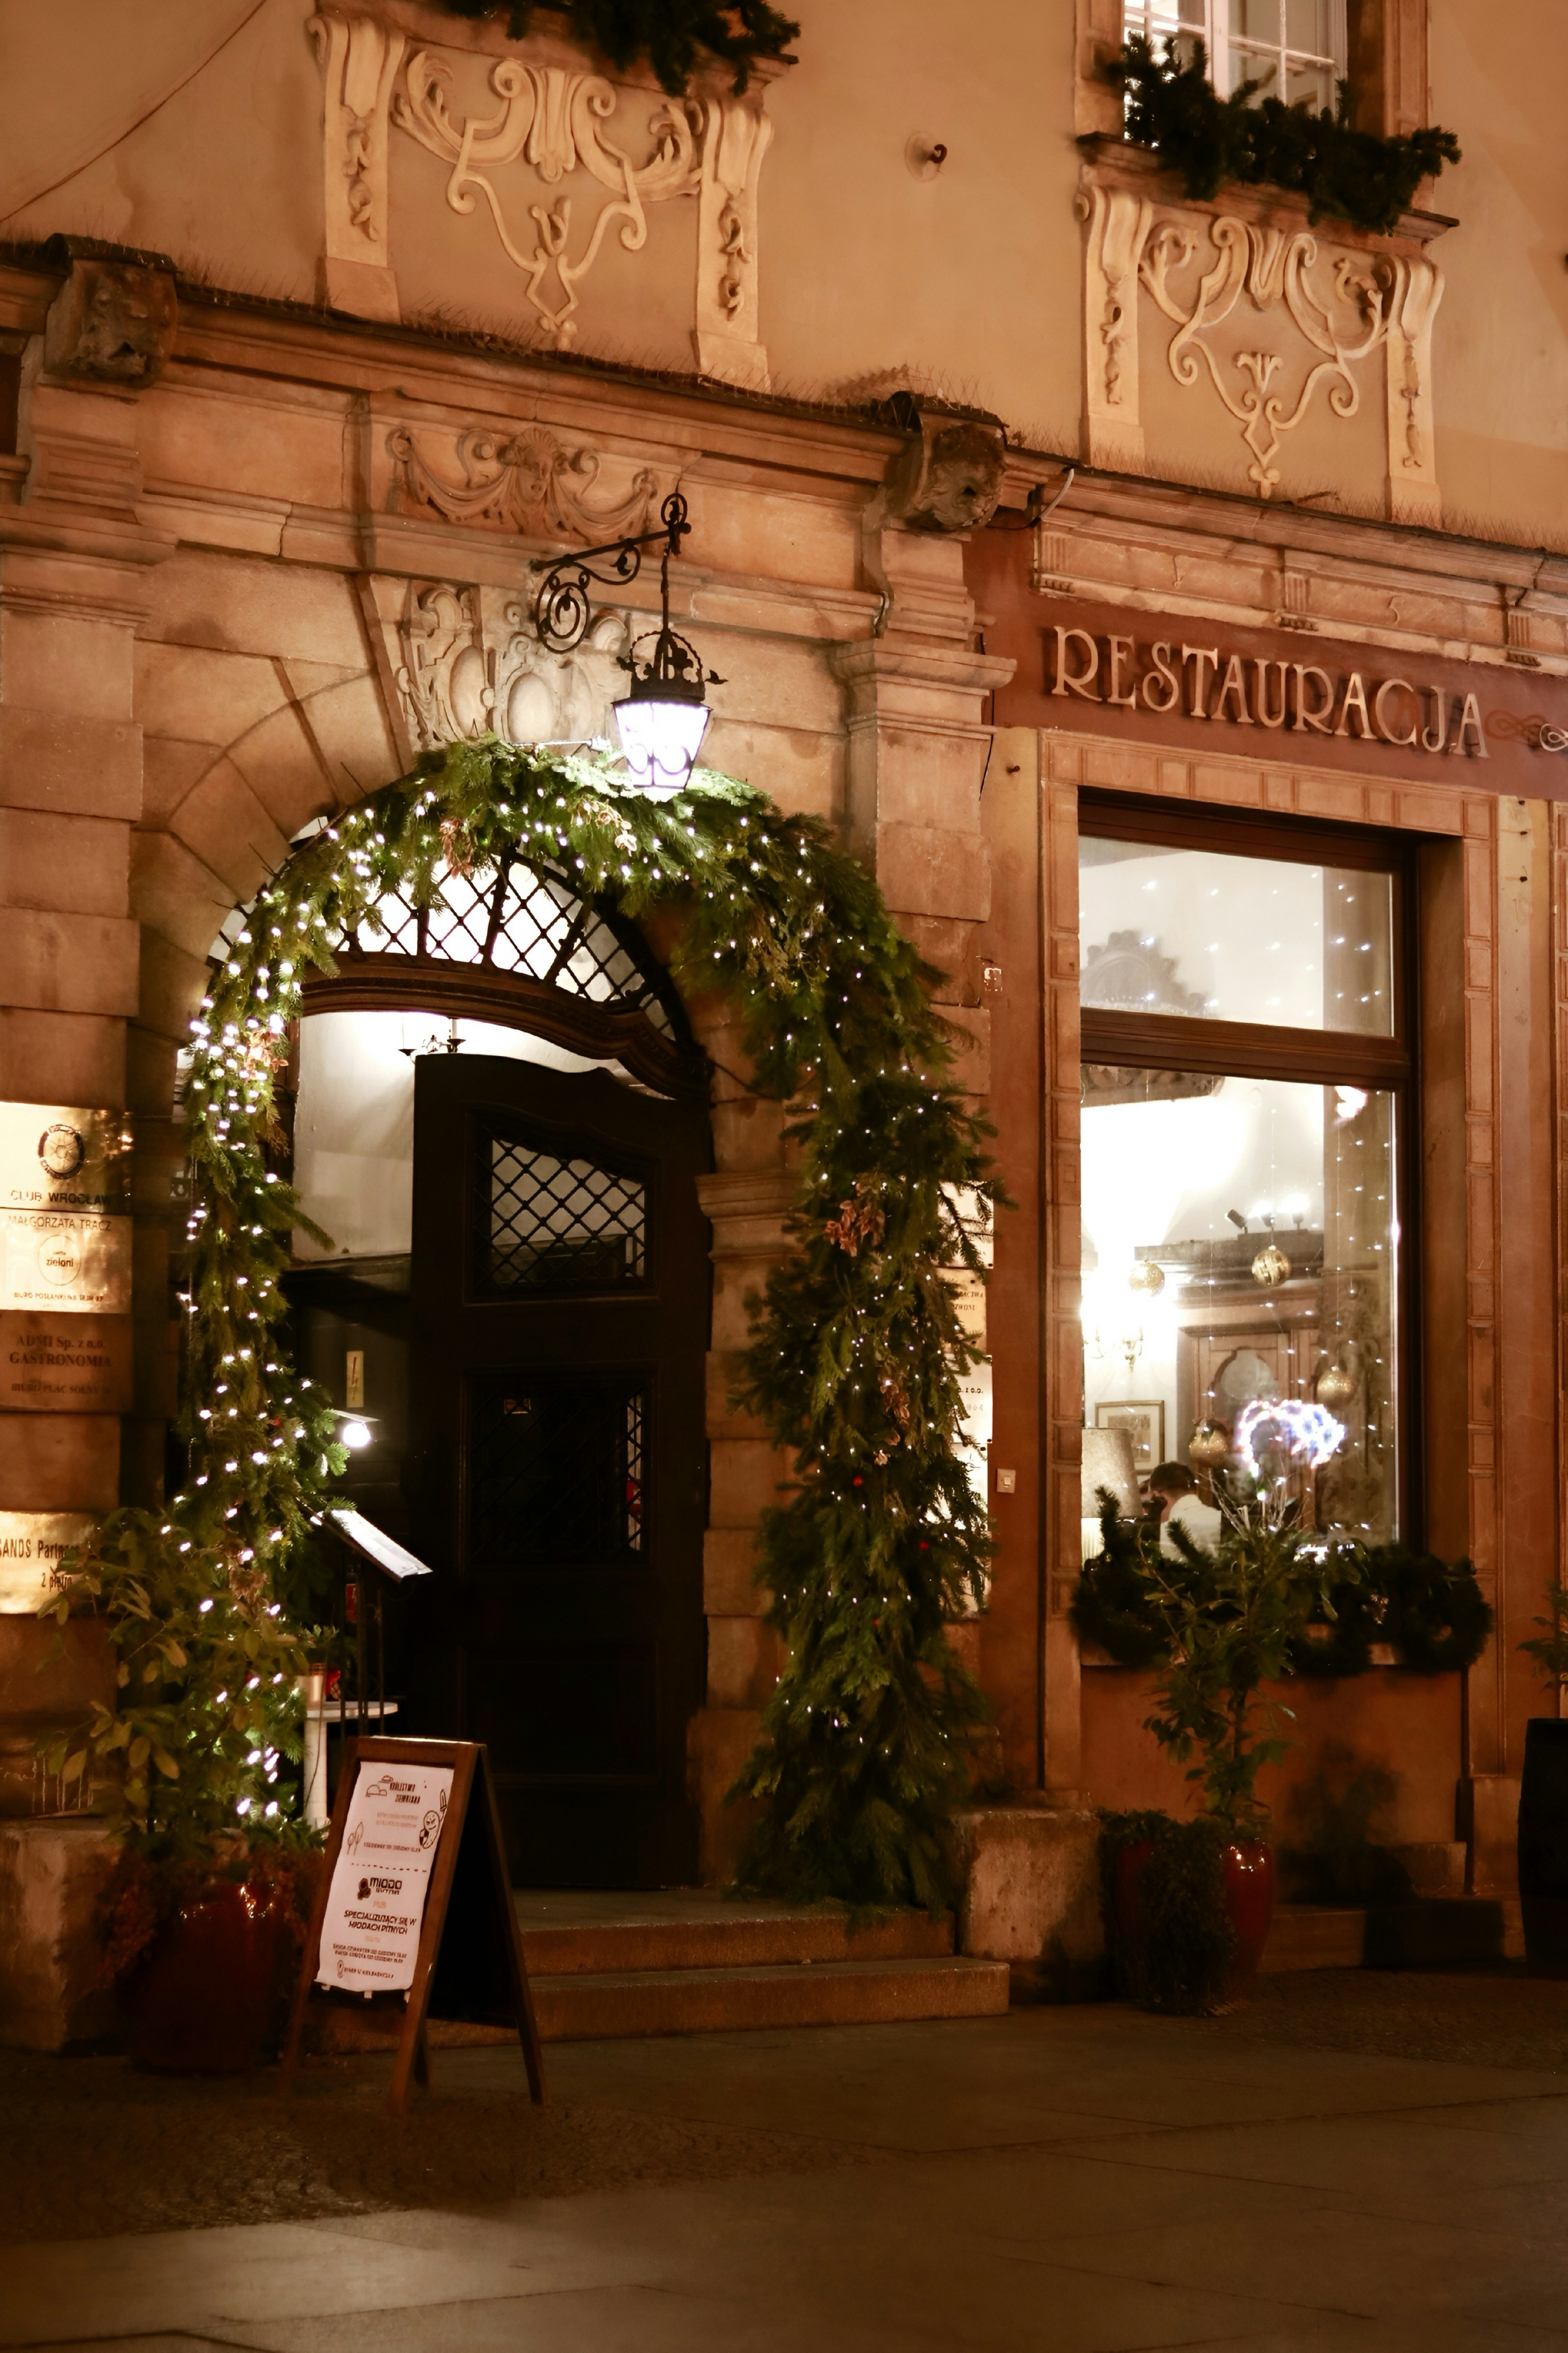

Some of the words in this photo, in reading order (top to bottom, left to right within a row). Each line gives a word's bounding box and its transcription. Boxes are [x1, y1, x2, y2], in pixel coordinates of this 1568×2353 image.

[1051, 626, 1490, 758] RESTAURACJA
[11, 1190, 42, 1202] CLUB
[49, 1193, 110, 1205] WROCŁAW
[9, 1216, 75, 1228] MAŁGORZATA
[80, 1219, 111, 1231] TRACZ
[46, 1257, 74, 1267] zieloni
[78, 1340, 83, 1348] z
[10, 1352, 111, 1367] GASTRONOMIA
[41, 1572, 46, 1587] 2
[370, 1877, 402, 1889] MIODO
